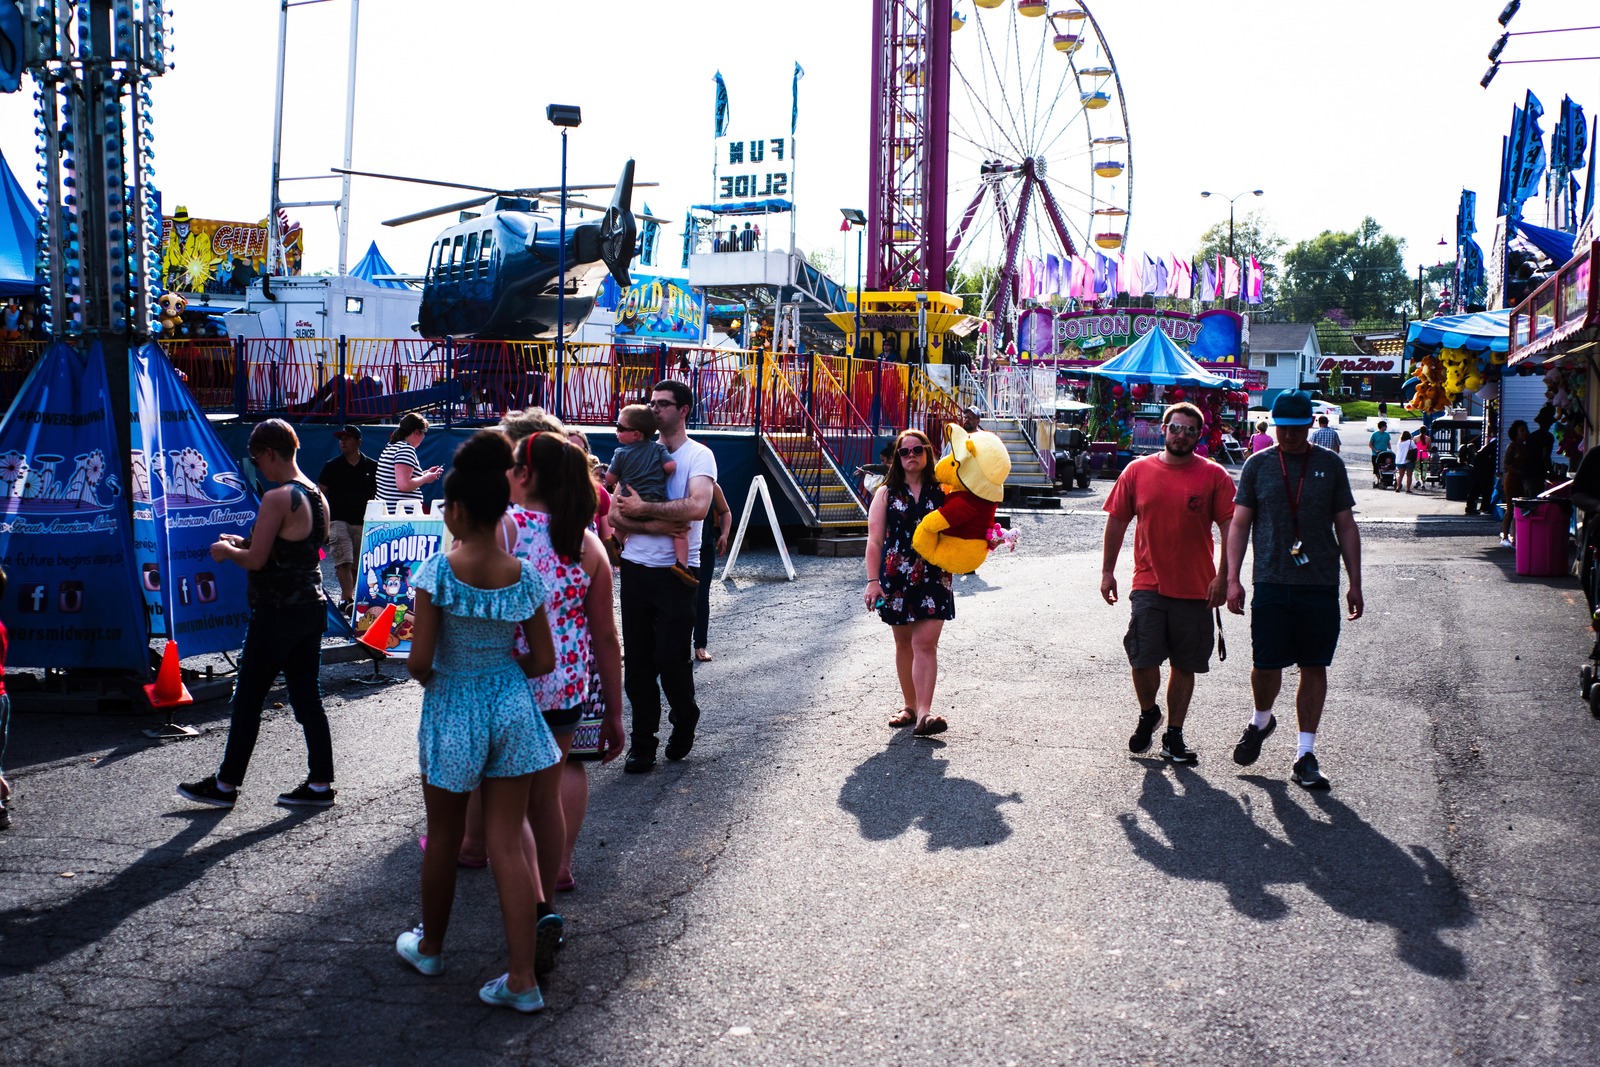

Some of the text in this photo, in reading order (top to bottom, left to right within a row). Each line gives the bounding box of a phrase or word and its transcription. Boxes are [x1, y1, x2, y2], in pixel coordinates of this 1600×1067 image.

[212, 225, 267, 257] GUN
[615, 282, 662, 324] GOLD
[1057, 314, 1203, 344] COTTON CANDY
[1319, 357, 1395, 372] AutoZone
[206, 508, 255, 526] Midways
[368, 522, 415, 553] Powers
[15, 551, 55, 567] future
[362, 535, 438, 574] FOOD COURT
